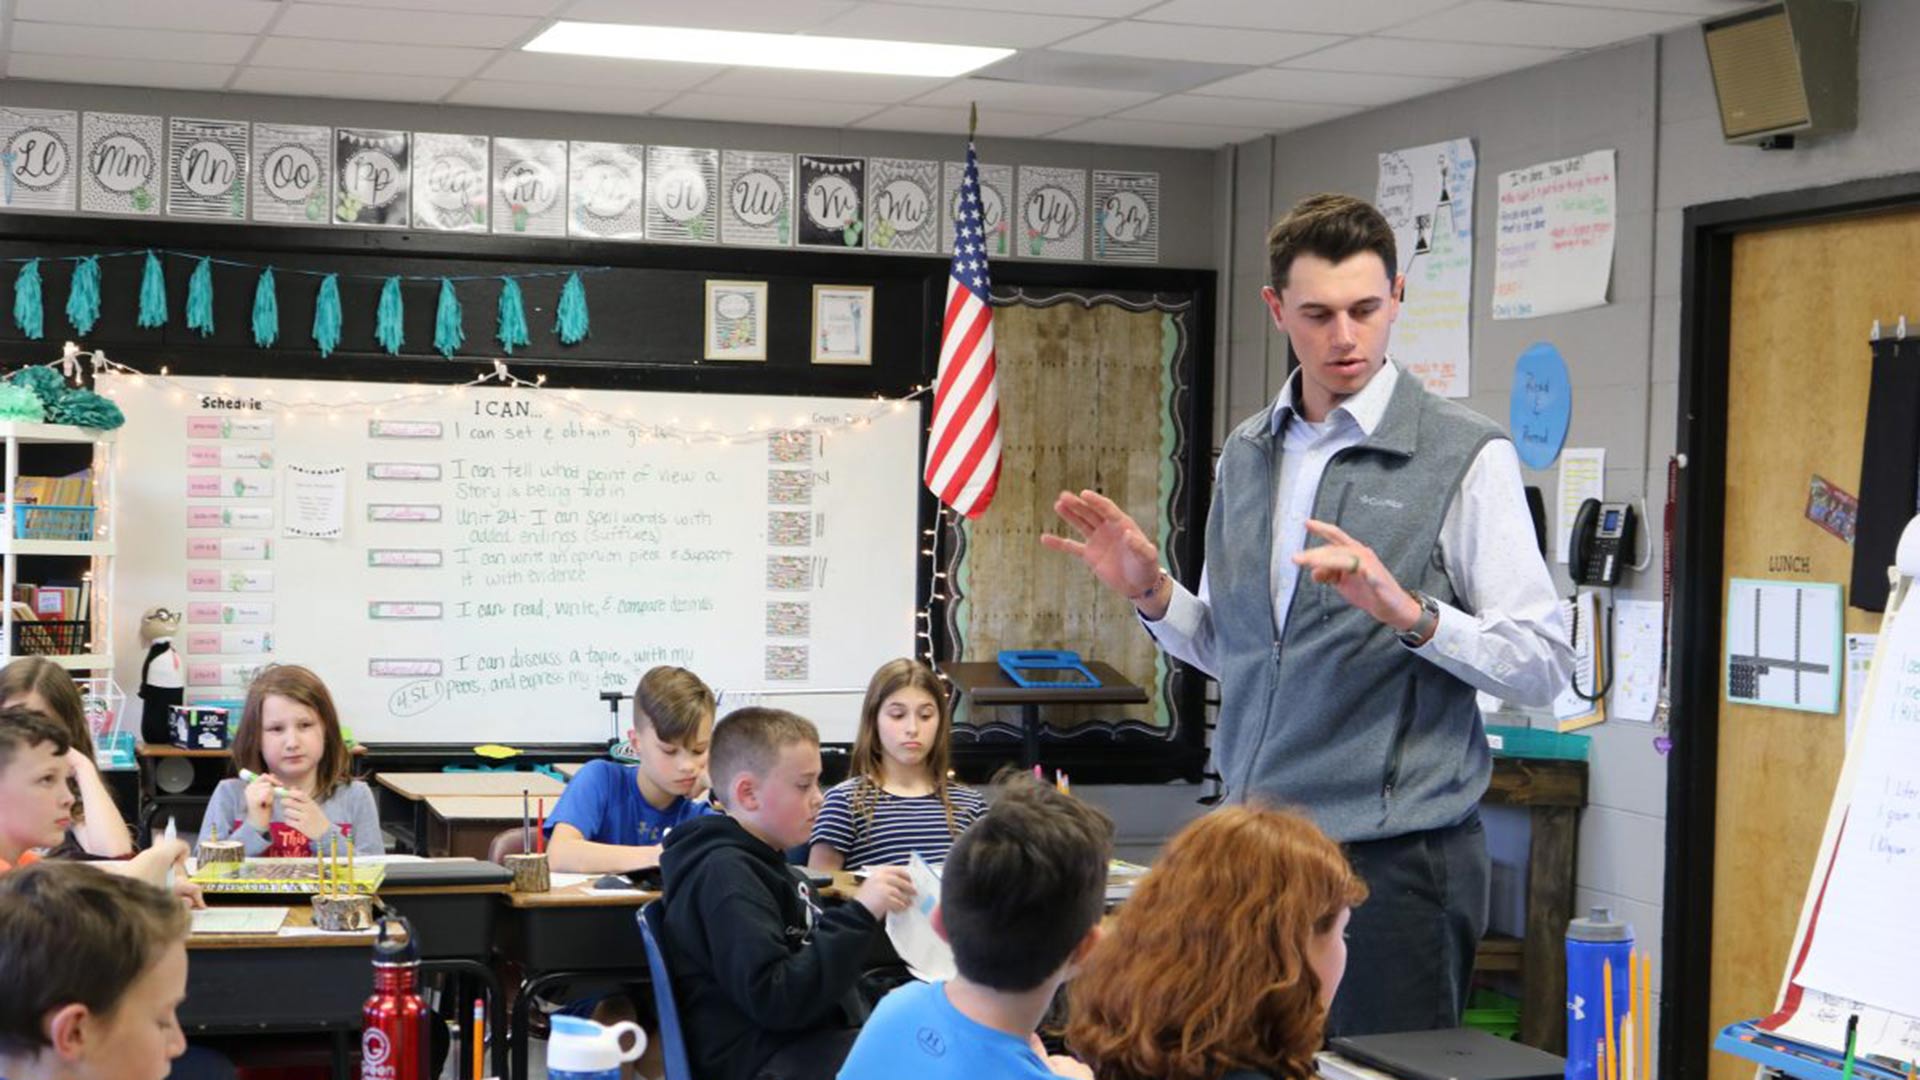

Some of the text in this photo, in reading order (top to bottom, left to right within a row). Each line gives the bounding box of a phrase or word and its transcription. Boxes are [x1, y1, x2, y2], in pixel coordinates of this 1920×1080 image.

[16, 140, 59, 177] Ll
[93, 144, 151, 181] Mm
[185, 148, 235, 186] Nn
[273, 154, 317, 190] Oo
[355, 156, 394, 205] Pp
[736, 180, 782, 216] Uu
[814, 184, 854, 219] Vv
[879, 190, 928, 223] Ww
[1033, 194, 1075, 236] Yy
[1107, 196, 1149, 236] Zz
[202, 396, 262, 410] Schedle
[474, 401, 480, 415] I
[455, 422, 460, 439] I
[470, 428, 495, 439] can
[504, 422, 528, 439] set
[563, 422, 611, 438] obtain
[451, 460, 465, 479] I
[471, 464, 496, 479] can
[503, 461, 530, 479] tell
[540, 461, 580, 479] what
[587, 466, 626, 484] point
[658, 466, 696, 483] view
[705, 470, 721, 483] a
[456, 483, 501, 506] Story
[507, 485, 521, 498] is
[526, 483, 570, 504] being
[457, 510, 489, 525] Unit
[529, 509, 546, 526] I
[555, 511, 580, 524] can
[588, 510, 619, 530] spell
[623, 511, 667, 525] words
[674, 512, 713, 526] with
[469, 528, 512, 544] added
[519, 528, 577, 545] endings
[454, 548, 472, 564] I
[481, 552, 509, 565] can
[511, 550, 543, 564] write
[571, 551, 622, 566] opinion
[681, 548, 733, 565] support
[1769, 555, 1811, 573] LUNCH
[485, 571, 522, 586] with
[528, 568, 587, 585] evidence
[454, 601, 471, 618] I
[477, 603, 506, 618] can
[617, 599, 665, 615] compare
[454, 654, 471, 672] I
[477, 657, 505, 672] can
[510, 647, 562, 668] discuss
[569, 649, 581, 663] a
[671, 647, 694, 667] my
[490, 673, 515, 692] and
[520, 671, 563, 691] express
